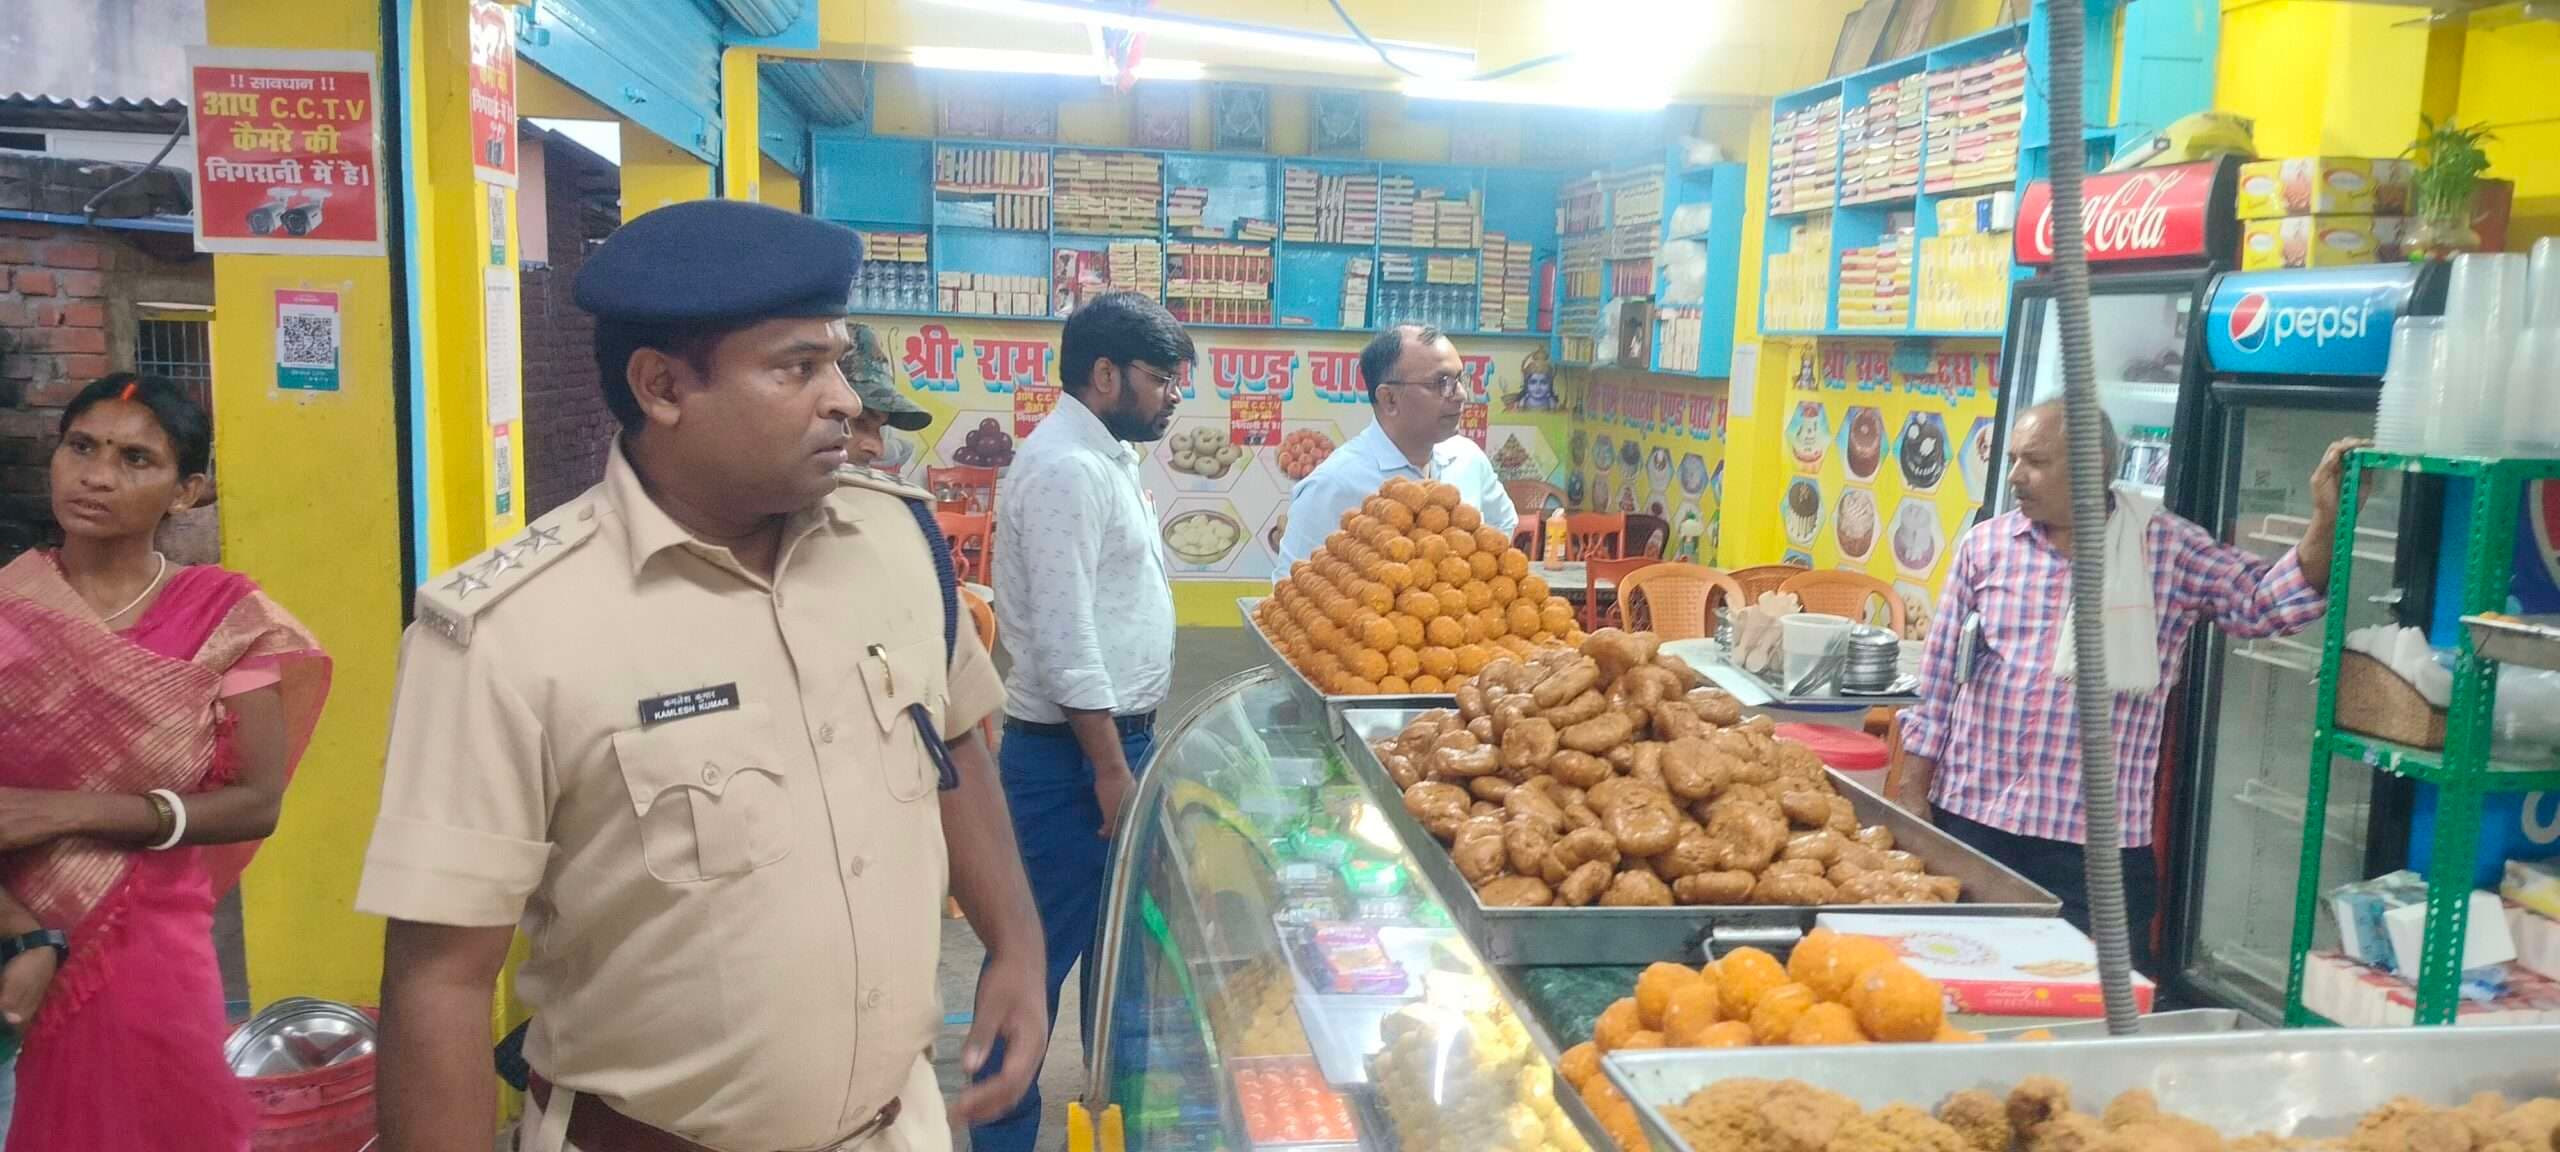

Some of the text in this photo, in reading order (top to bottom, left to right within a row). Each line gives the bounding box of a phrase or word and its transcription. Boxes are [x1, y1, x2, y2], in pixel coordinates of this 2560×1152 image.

[230, 74, 336, 91] !! सावधान !!
[202, 91, 364, 121] आप C.C.T.V
[229, 121, 342, 154] कैमरे की
[204, 156, 303, 184] निगरानी
[310, 159, 333, 185] में
[2274, 302, 2368, 348] pepsi
[902, 323, 963, 391] श्री
[973, 339, 1053, 392] राम
[1208, 347, 1299, 400] एण्ड
[655, 697, 729, 720] KAMLESH KUMAR
